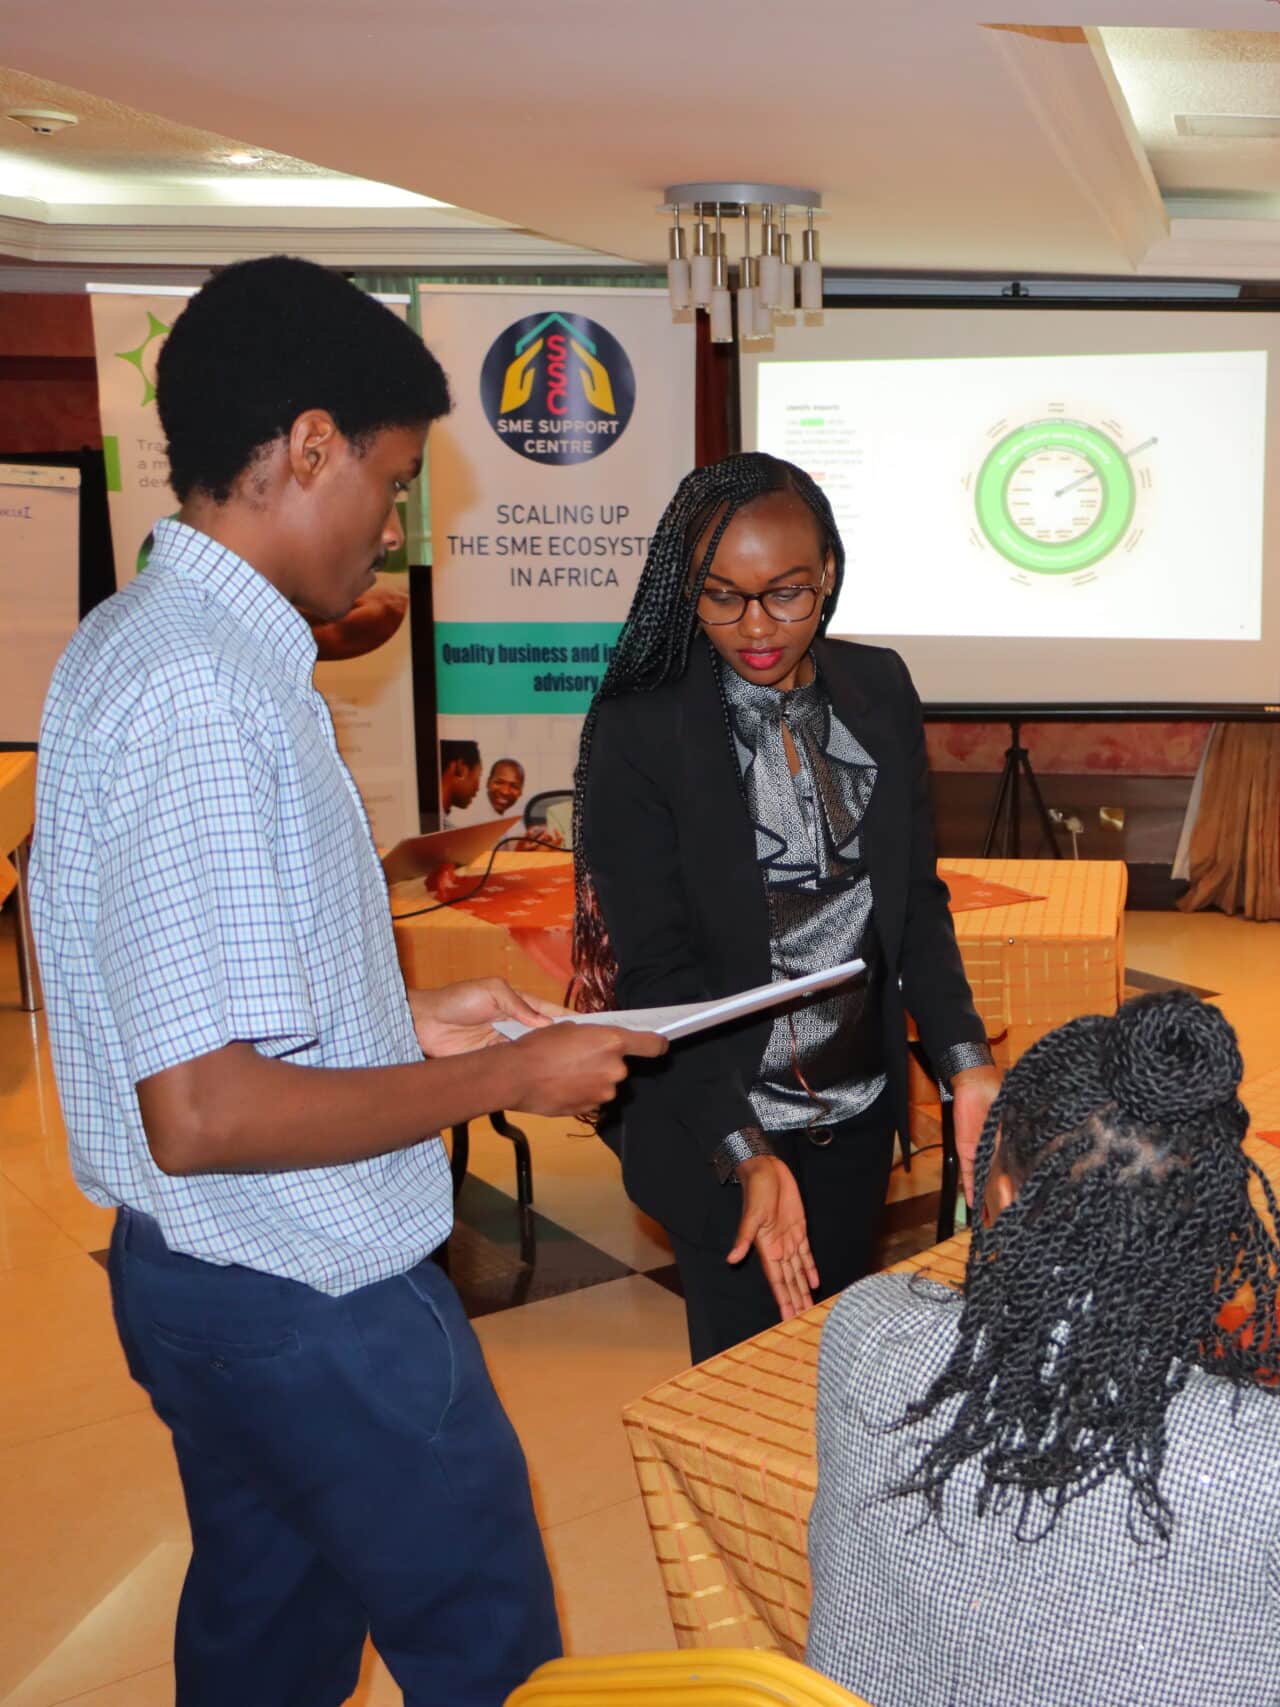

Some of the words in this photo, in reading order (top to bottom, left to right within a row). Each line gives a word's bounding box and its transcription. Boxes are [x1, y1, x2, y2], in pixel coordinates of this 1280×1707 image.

[497, 419, 534, 433] SME
[538, 420, 620, 434] SUPPORT
[524, 440, 593, 453] CENTRE
[496, 504, 594, 525] SCALING
[600, 505, 630, 525] UP
[447, 536, 489, 556] THE
[495, 536, 543, 556] SME
[510, 567, 532, 587] IN
[537, 567, 620, 587] AFRICA
[442, 643, 495, 665] Quality
[498, 643, 568, 664] business
[571, 643, 599, 663] and
